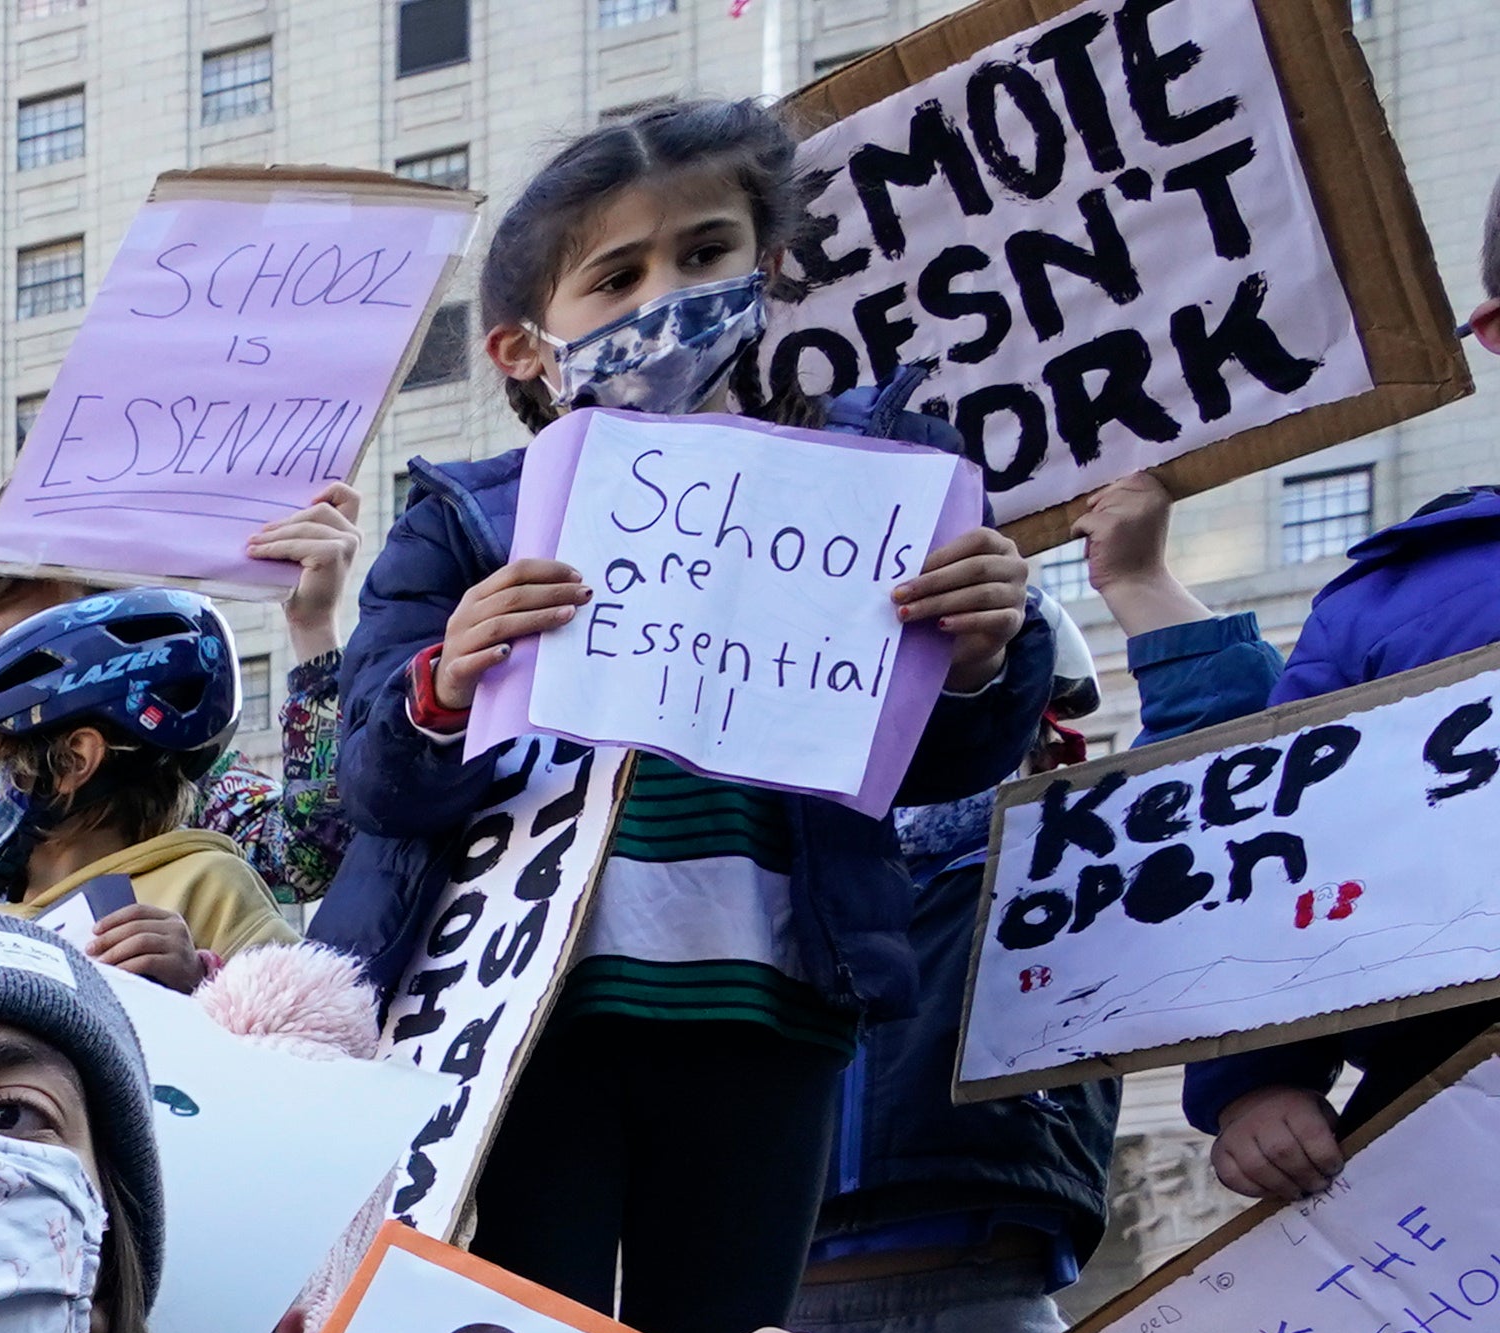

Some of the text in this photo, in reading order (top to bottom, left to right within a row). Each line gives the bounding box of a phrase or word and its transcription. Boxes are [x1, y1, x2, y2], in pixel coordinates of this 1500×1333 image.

[785, 1, 1245, 288] EMOTE
[129, 241, 413, 320] SCHOOL
[768, 137, 1257, 402] OESN'T
[226, 334, 273, 366] IS
[920, 272, 1325, 493] ORK
[38, 394, 366, 491] ESSENTIAL
[609, 448, 914, 583] Schools
[604, 550, 712, 595] are
[56, 644, 174, 695] LAZER
[585, 602, 890, 698] Essential
[385, 738, 541, 1066] HOOL
[393, 1001, 506, 1227] VER
[1315, 1205, 1447, 1301] THE
